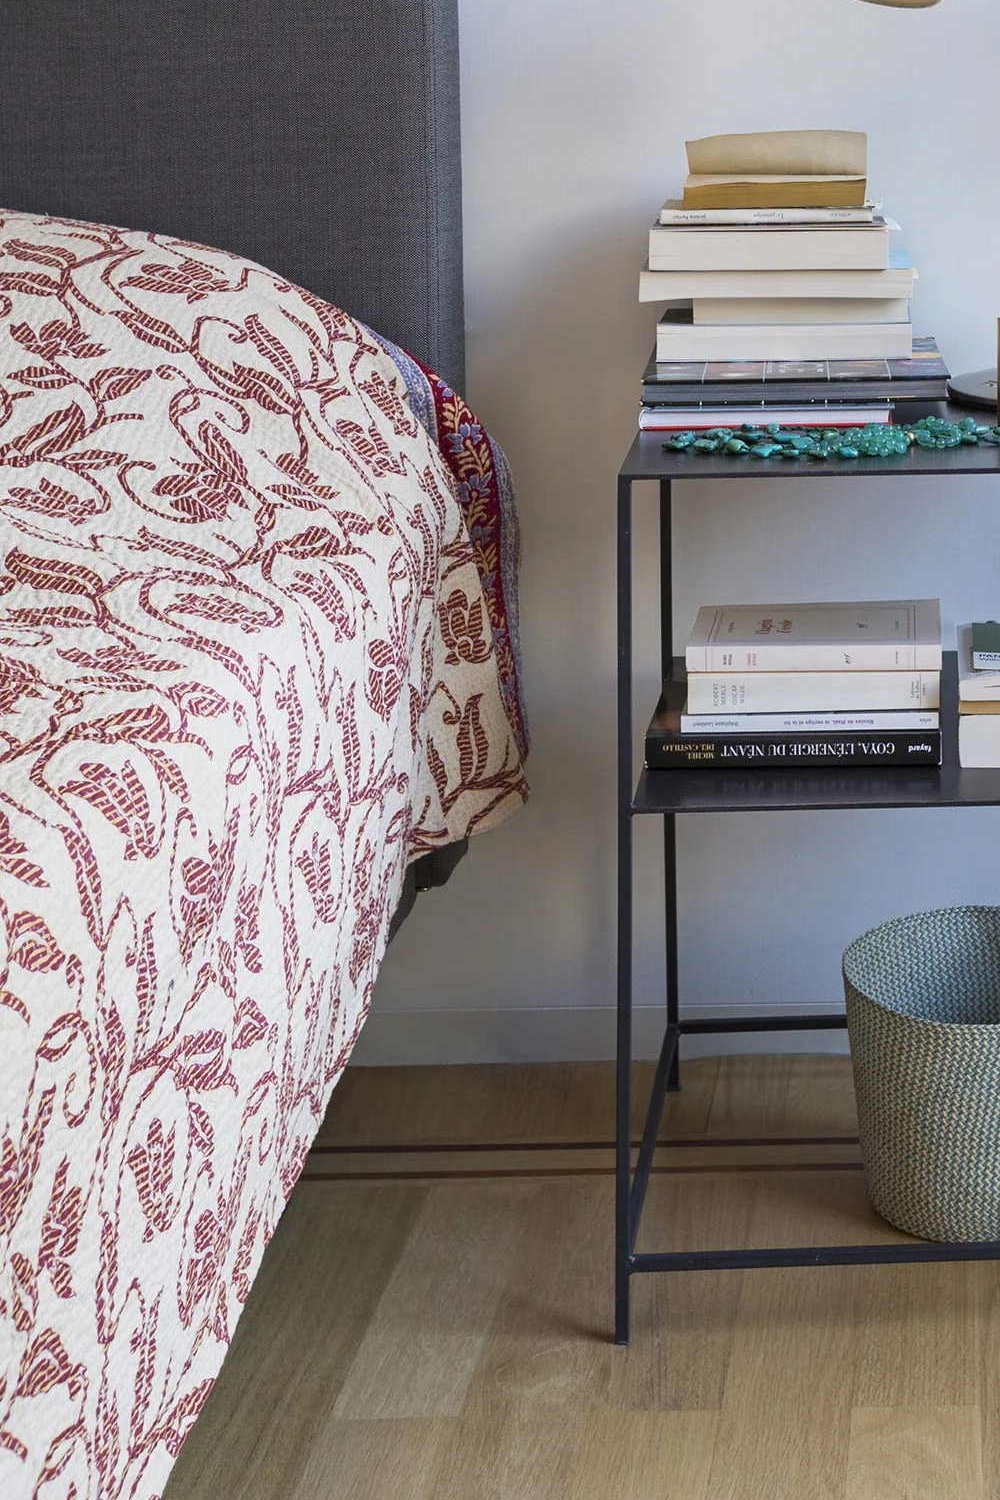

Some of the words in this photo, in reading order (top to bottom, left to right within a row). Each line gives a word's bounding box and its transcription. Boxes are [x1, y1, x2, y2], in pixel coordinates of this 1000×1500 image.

[721, 744, 764, 759] NÉANT
[768, 744, 786, 756] DU
[790, 742, 854, 758] L'ÉNERGIE
[858, 742, 895, 755] GOYA,
